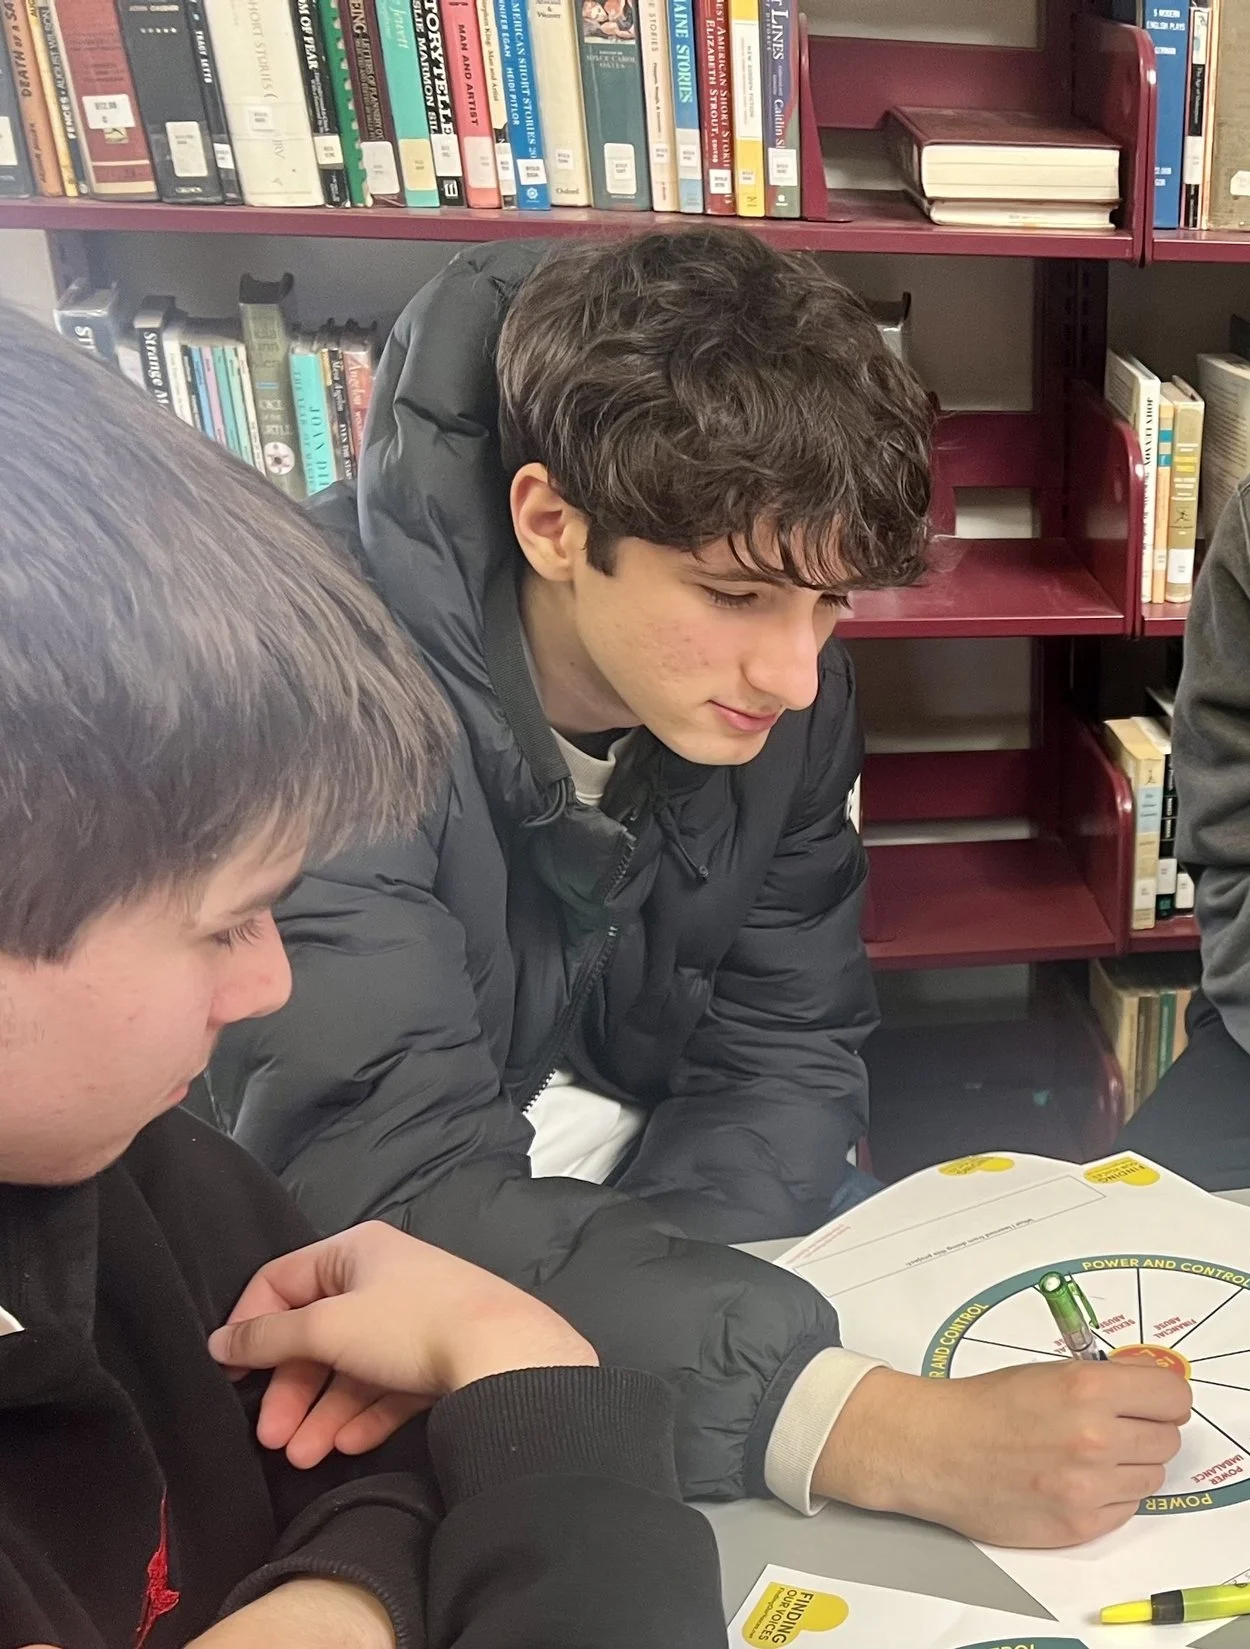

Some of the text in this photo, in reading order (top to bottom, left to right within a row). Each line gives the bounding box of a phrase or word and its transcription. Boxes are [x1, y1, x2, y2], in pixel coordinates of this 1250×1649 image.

[195, 31, 208, 55] TRACY
[300, 17, 318, 69] OF FEAR
[648, 13, 660, 52] STORIES
[771, 9, 789, 60] LINES
[1169, 23, 1186, 31] PLAYS
[13, 50, 32, 97] DEATH
[417, 38, 434, 107] MARMON
[458, 24, 479, 125] MAN AND ARTIST
[673, 0, 693, 104] AINE STORIES
[705, 20, 718, 86] ELIZABETH
[716, 17, 731, 127] AMERICAN SHORT
[502, 33, 520, 126] EGAN HEIDI PITLOR
[518, 57, 537, 145] SHORT STORIES
[774, 99, 786, 137] Caitlin
[143, 331, 163, 394] Strange
[309, 406, 325, 450] JOAN
[1082, 1258, 1250, 1288] POWER AND CONTROL
[930, 1303, 989, 1370] AND CONTROL
[1102, 1318, 1136, 1335] SEXUAL
[1153, 1318, 1197, 1339] FINANCIAL
[1154, 1316, 1181, 1331] ABUSE
[1190, 1454, 1244, 1484] IMBALANCE
[1210, 1465, 1243, 1486] POWER
[1145, 1493, 1213, 1512] POWER
[758, 1588, 798, 1641] OUR VOICES
[772, 1591, 815, 1644] FINDING
